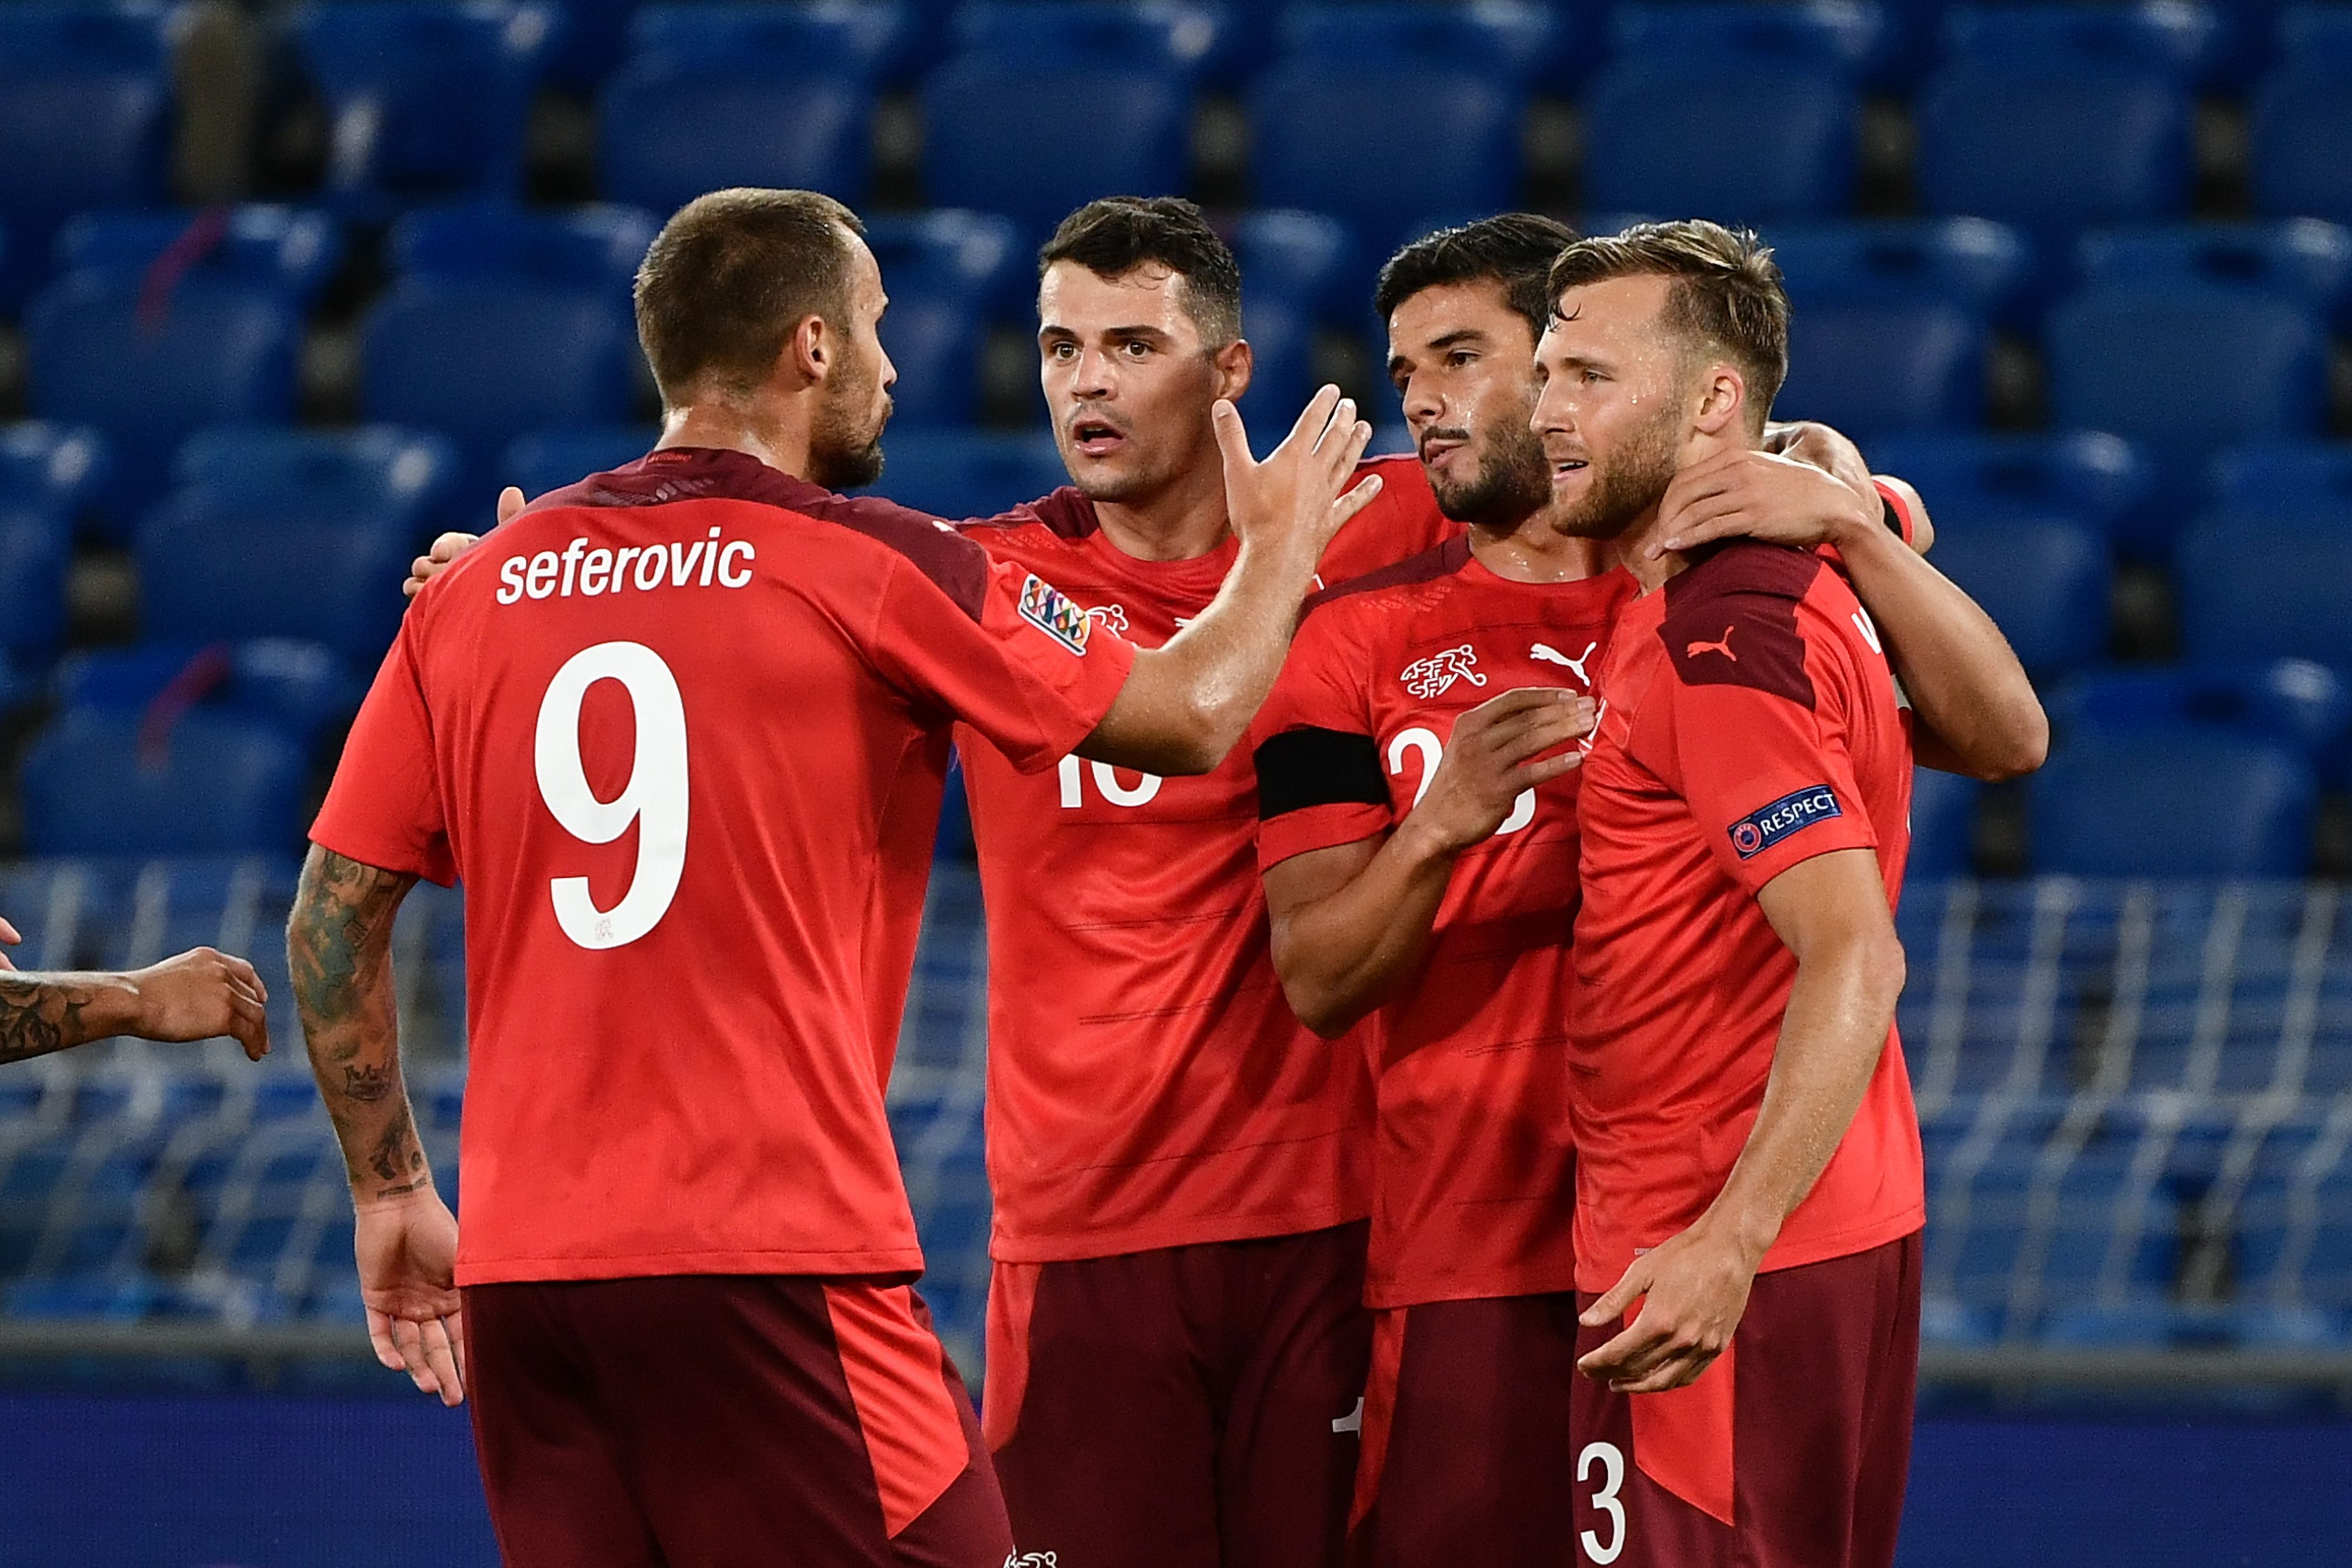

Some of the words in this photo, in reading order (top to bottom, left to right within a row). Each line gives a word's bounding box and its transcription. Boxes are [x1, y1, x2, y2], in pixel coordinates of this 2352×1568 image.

[496, 526, 755, 604] seferovic
[534, 641, 689, 950] 9
[1388, 728, 1536, 835] 2
[1760, 794, 1835, 835] RESPECT
[1577, 1442, 1626, 1565] 3
